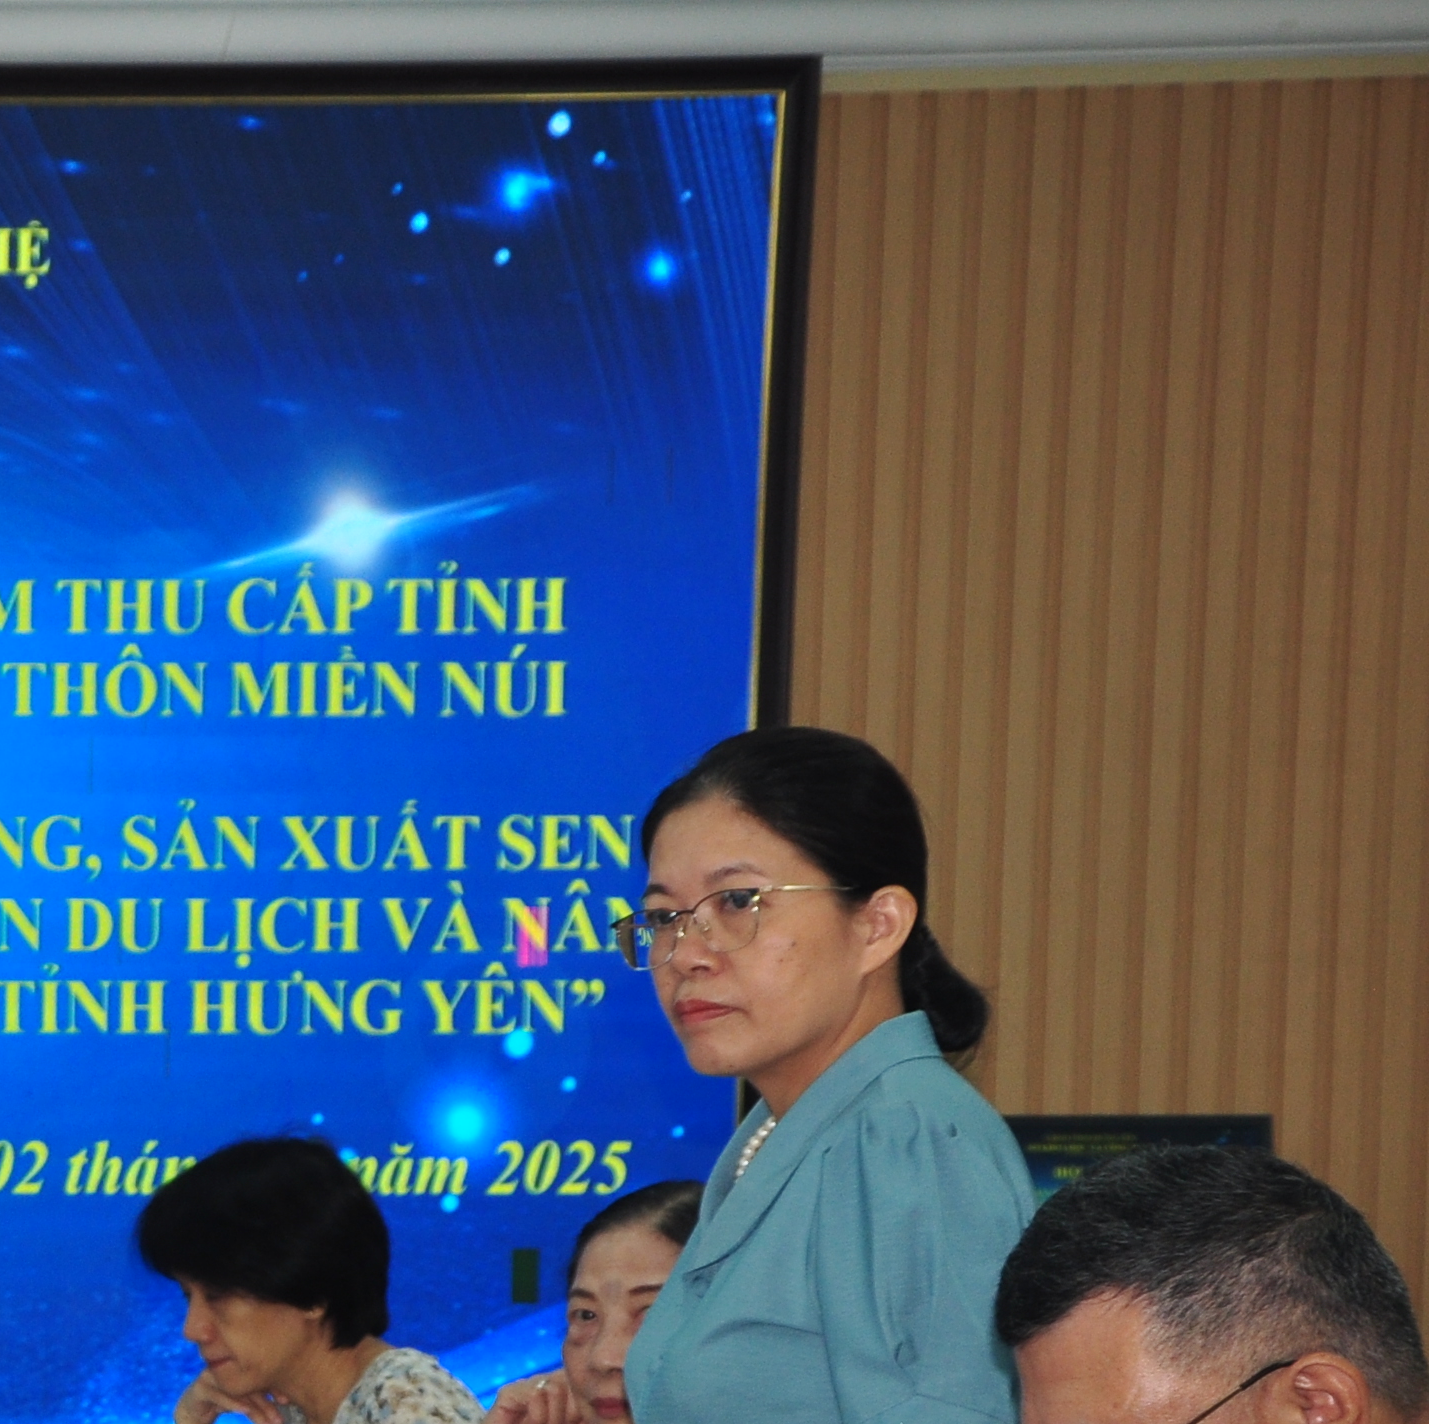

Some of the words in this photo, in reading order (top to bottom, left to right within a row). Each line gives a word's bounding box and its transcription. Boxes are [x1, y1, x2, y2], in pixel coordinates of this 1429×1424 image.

[56, 577, 206, 635] THU
[227, 561, 373, 635] CẤP
[387, 561, 567, 635] TỈNH
[2, 643, 206, 717] THÔN
[230, 646, 419, 717] MIỀN
[440, 643, 567, 717] NÚI
[120, 799, 260, 871] SẢN
[280, 799, 482, 871] XUẤT
[496, 813, 636, 871] SEN
[66, 897, 162, 953] DU
[184, 897, 360, 969] LỊCH
[382, 881, 482, 953] VÀ
[190, 971, 402, 1035] HƯNG
[64, 1139, 196, 1195] thán
[348, 1143, 468, 1195] năm
[486, 1139, 632, 1195] 2025
